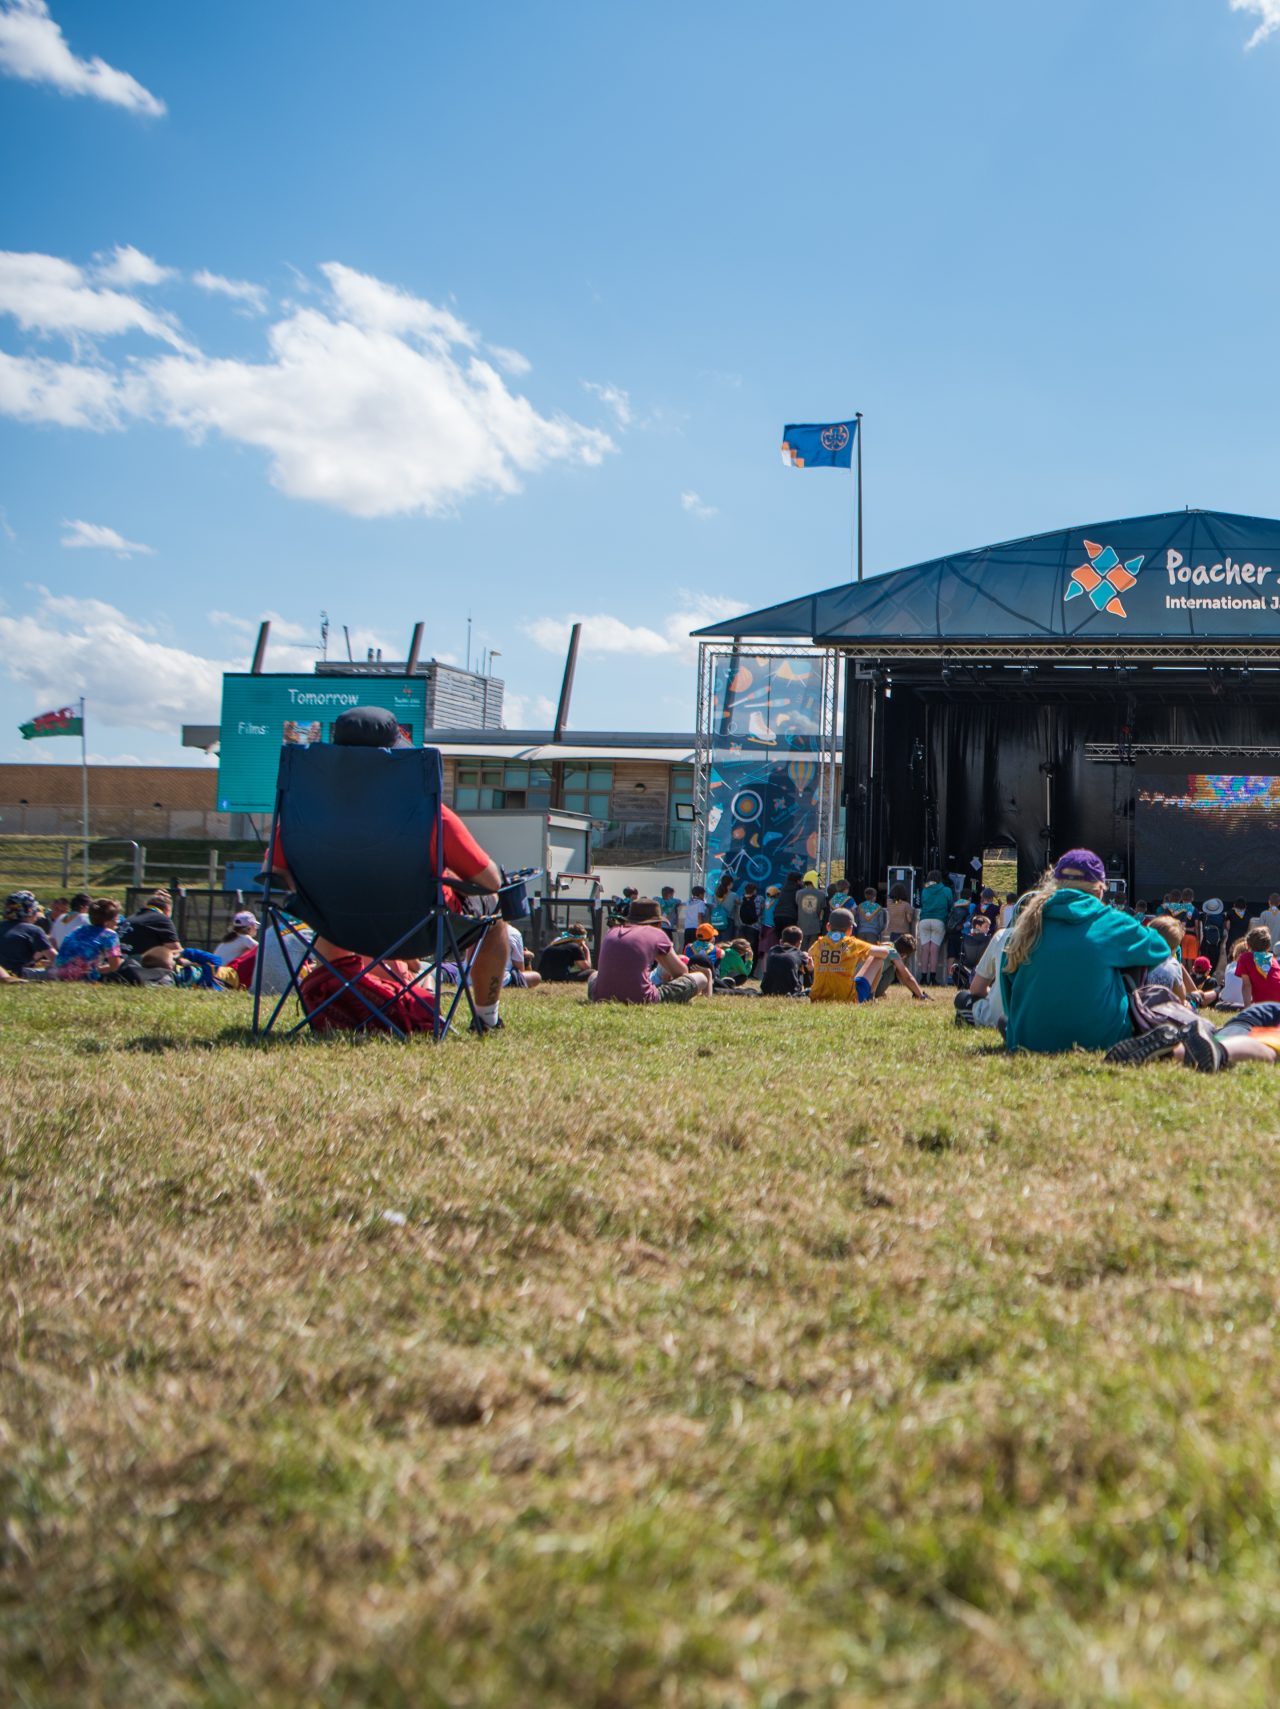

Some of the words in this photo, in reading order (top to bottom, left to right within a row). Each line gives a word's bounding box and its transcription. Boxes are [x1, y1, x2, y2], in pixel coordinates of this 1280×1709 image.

[1166, 548, 1272, 586] Poacher
[1165, 595, 1266, 610] International
[287, 688, 359, 706] Tomorrow
[820, 949, 841, 964] 86
